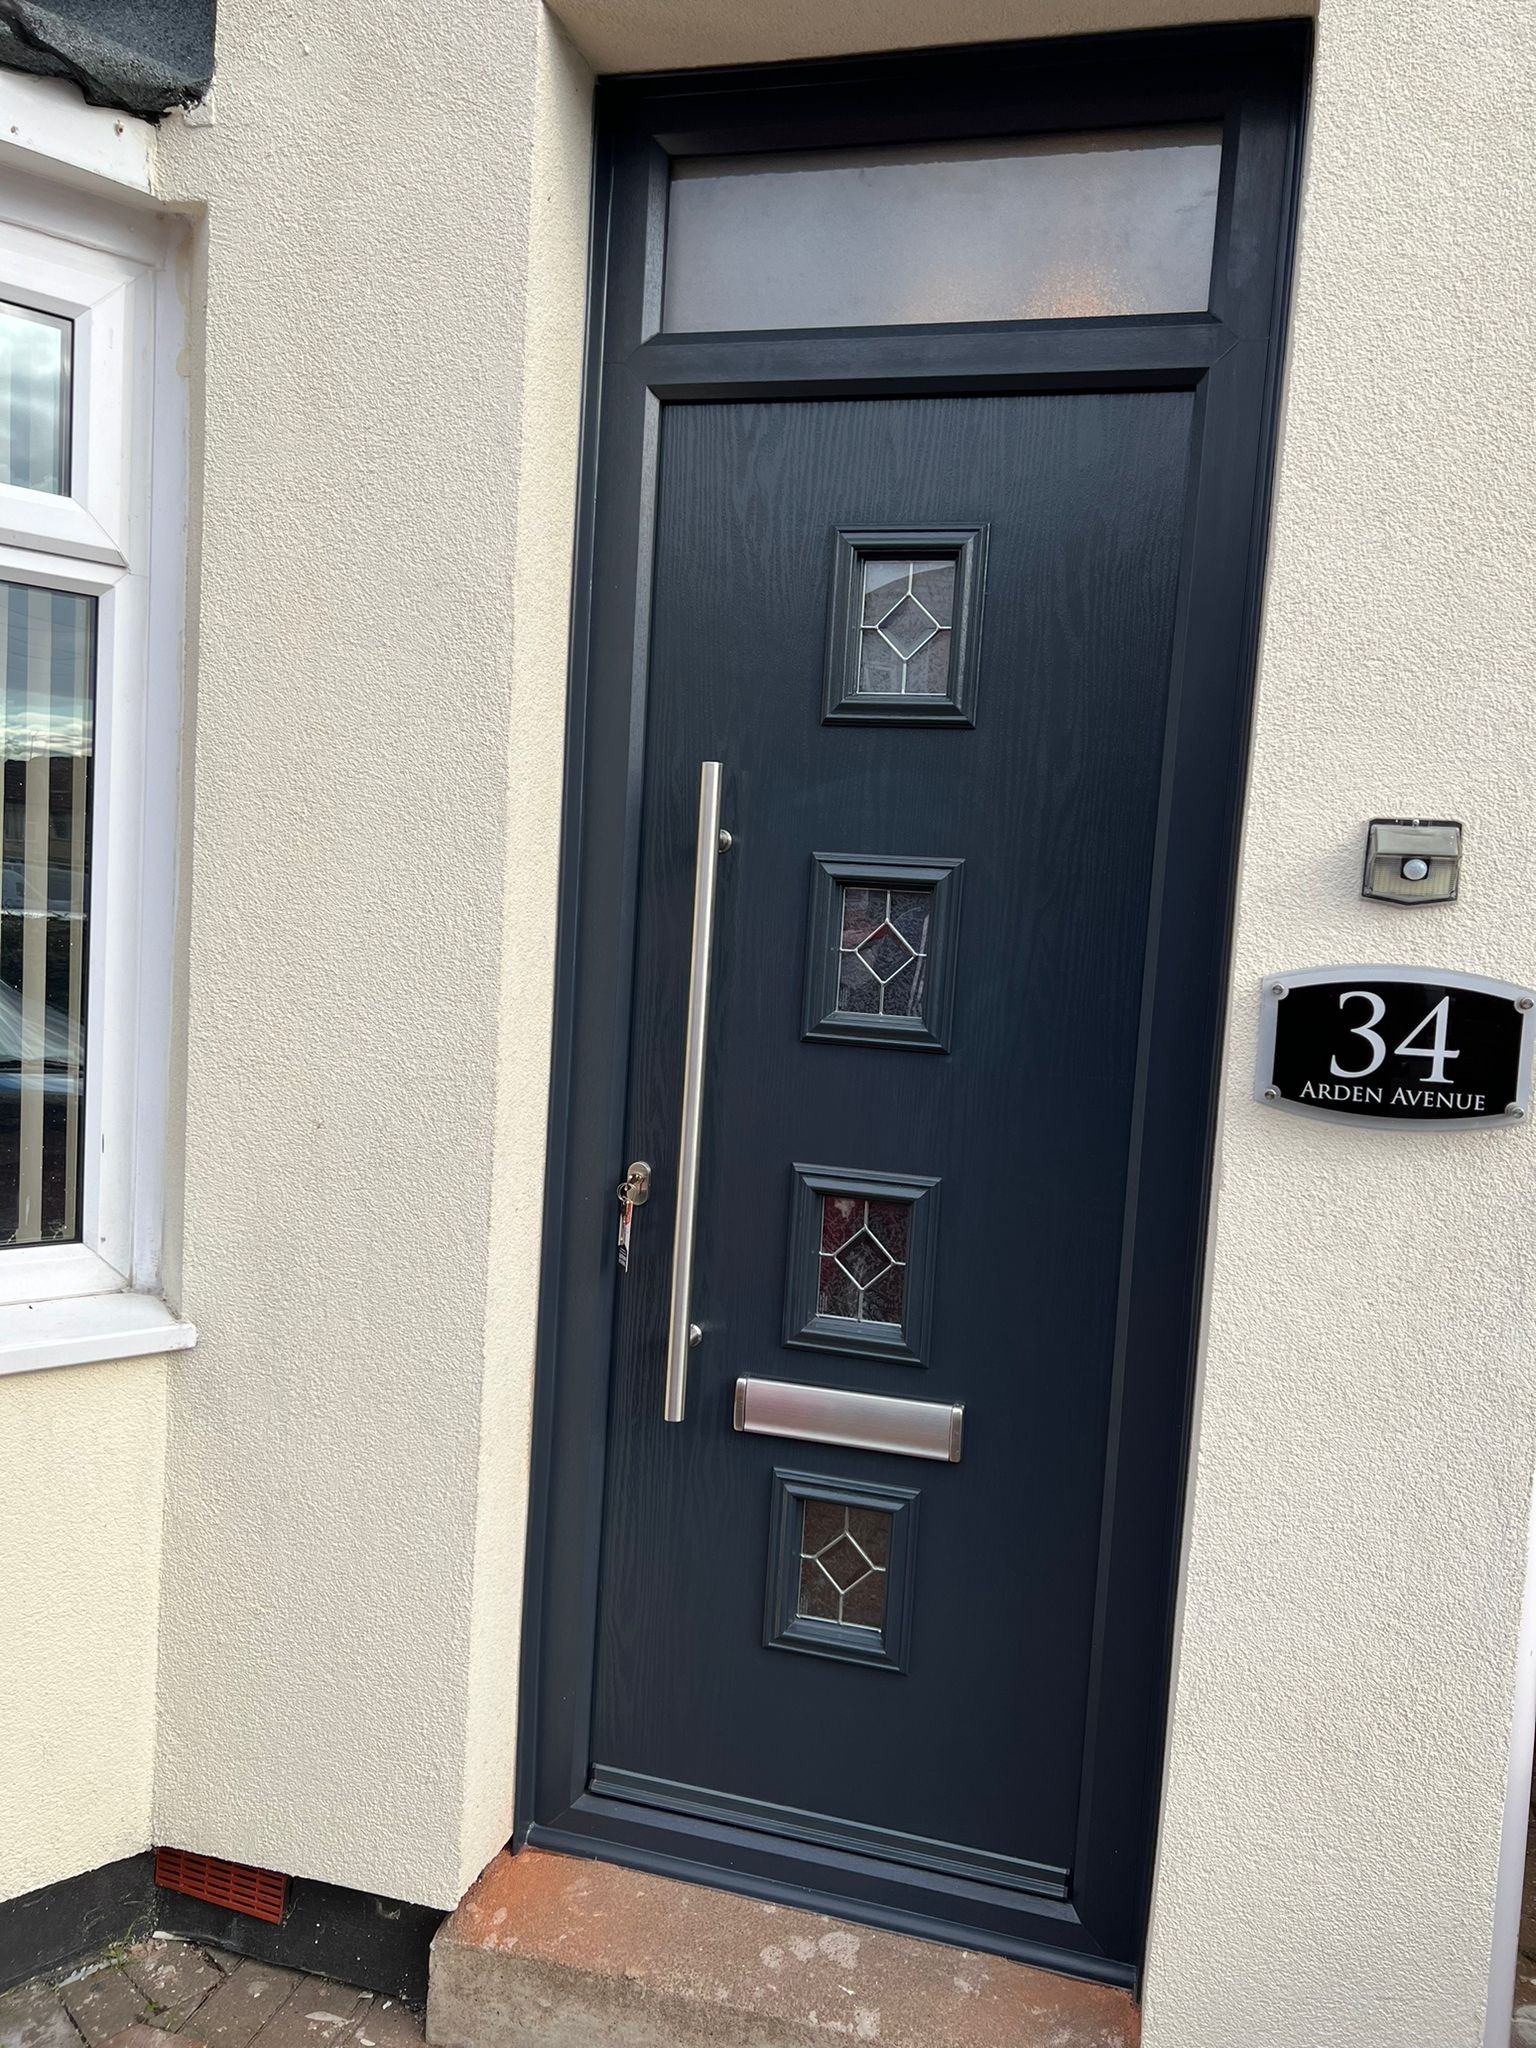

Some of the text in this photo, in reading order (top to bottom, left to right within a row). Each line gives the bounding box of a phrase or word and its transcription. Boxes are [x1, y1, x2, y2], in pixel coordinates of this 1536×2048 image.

[1329, 990, 1461, 1084] 34
[1299, 1080, 1486, 1111] ARDEN AVENUE
